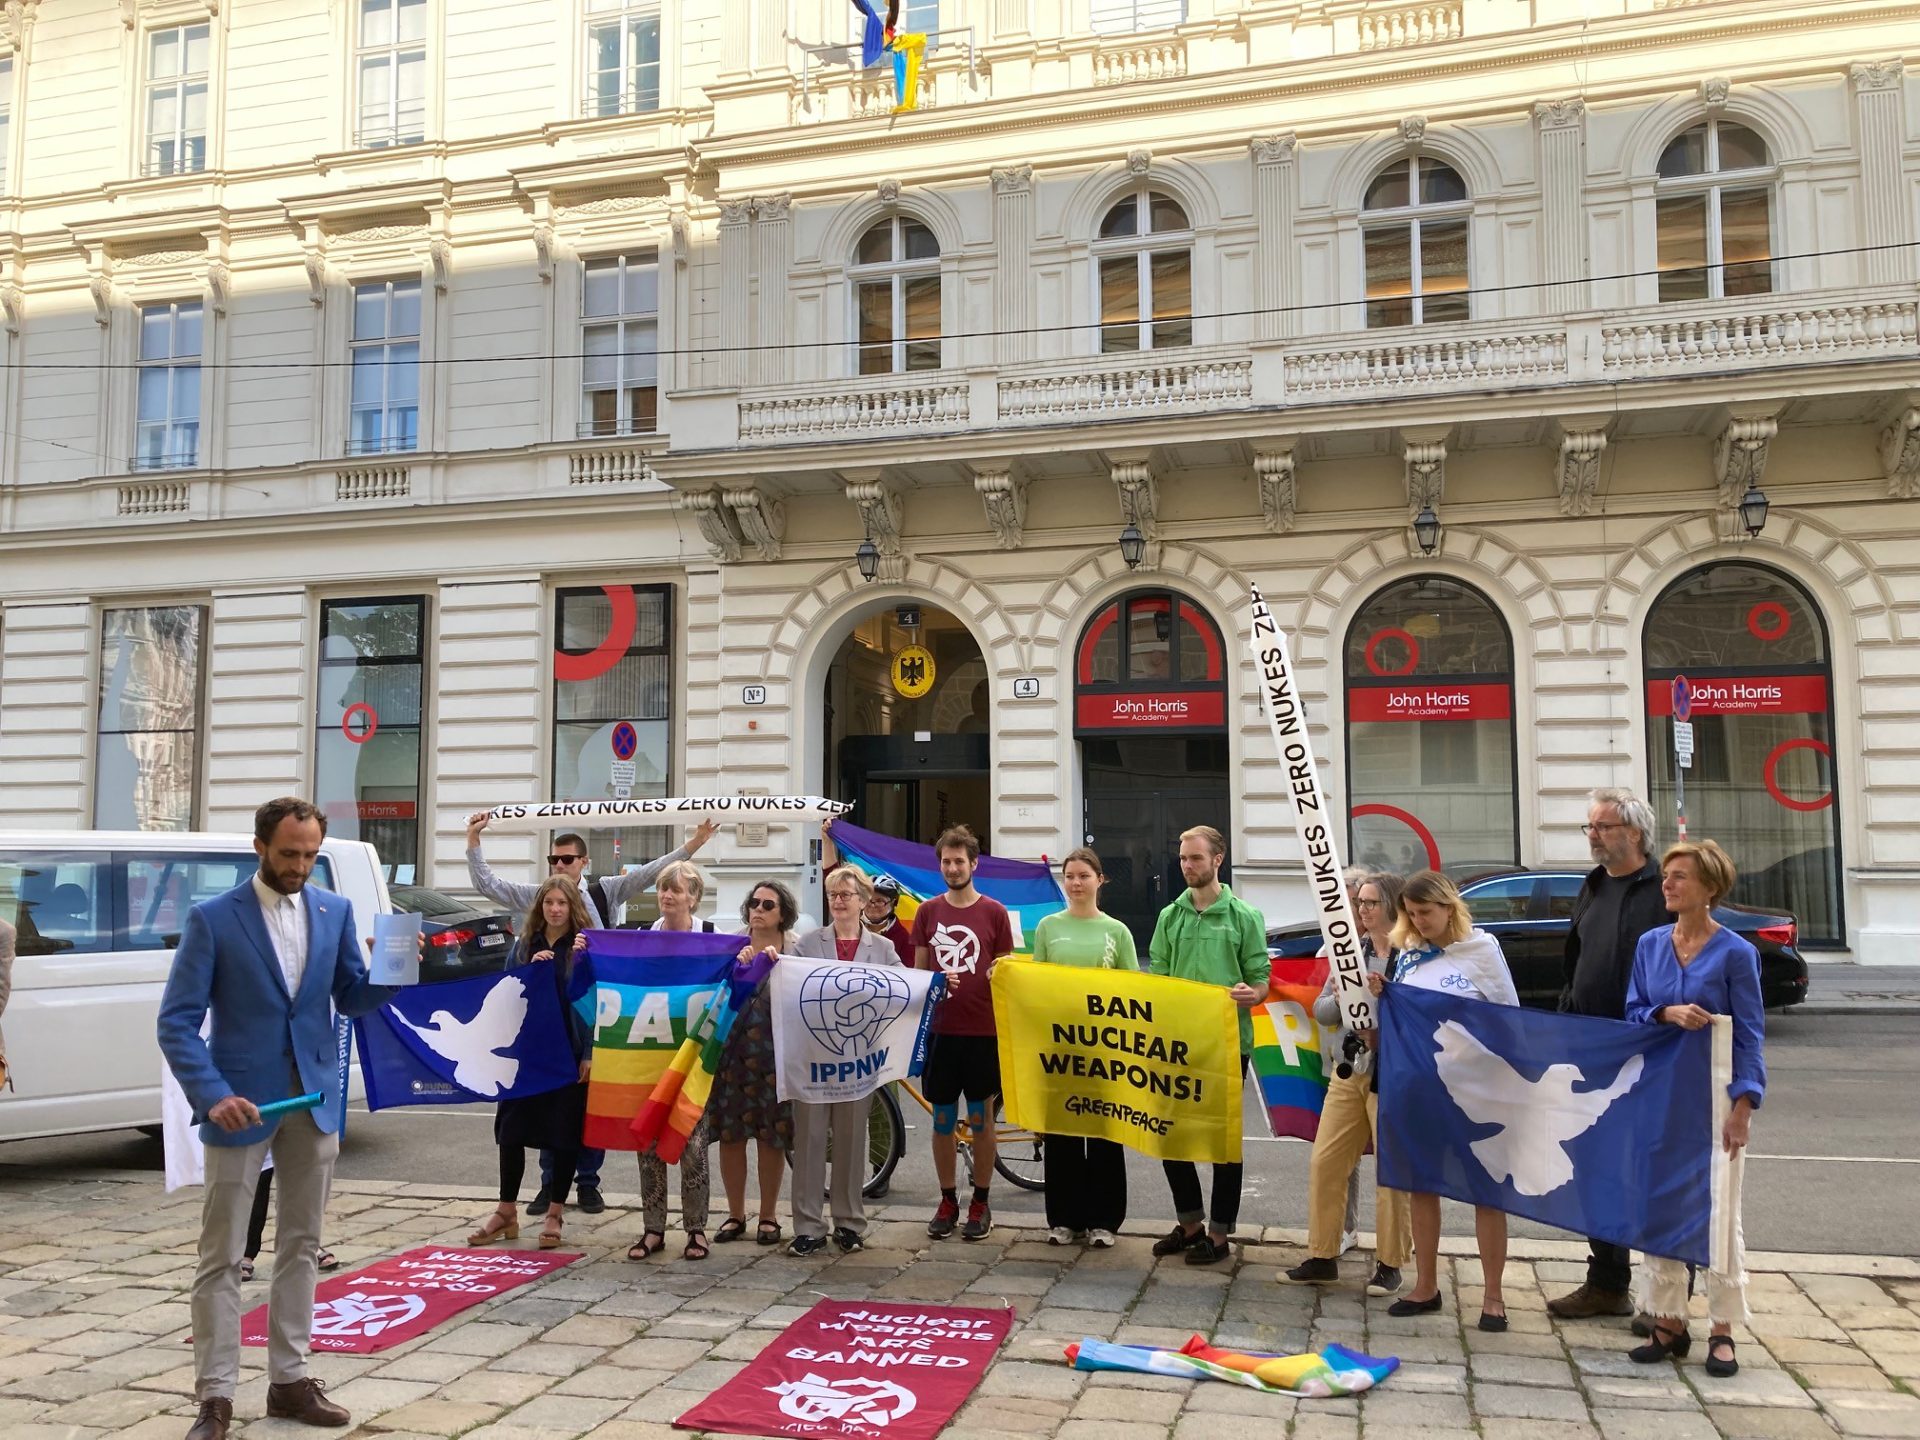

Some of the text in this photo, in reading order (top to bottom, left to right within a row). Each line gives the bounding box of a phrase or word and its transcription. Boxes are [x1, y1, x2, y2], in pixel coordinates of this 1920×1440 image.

[904, 614, 913, 624] 4
[1022, 680, 1030, 692] 4
[1261, 648, 1300, 736] NUKES
[1690, 684, 1782, 700] John Harris
[1112, 699, 1188, 713] John Harris
[1386, 692, 1470, 707] John Harris
[1712, 701, 1758, 709] Academy
[1284, 744, 1319, 814] ZERO
[368, 805, 398, 815] Harris
[536, 804, 591, 817] ZERO
[598, 800, 667, 814] NUKES
[677, 798, 731, 810] ZERO
[738, 797, 806, 810] NUKES
[1304, 825, 1344, 912] NUKES
[1328, 920, 1363, 992] ZERO
[1087, 994, 1153, 1022] BAN
[1350, 1002, 1372, 1030] ES
[1052, 1024, 1189, 1066] NUCLEAR
[810, 1046, 890, 1082] IPPNW
[1039, 1052, 1202, 1102] WEAPONS!
[1065, 1095, 1174, 1136] GREENPEACE
[425, 1251, 550, 1267] Nuclear
[839, 1310, 991, 1329] Nuclear
[848, 1336, 935, 1350] ARE
[786, 1347, 969, 1368] BANNED
